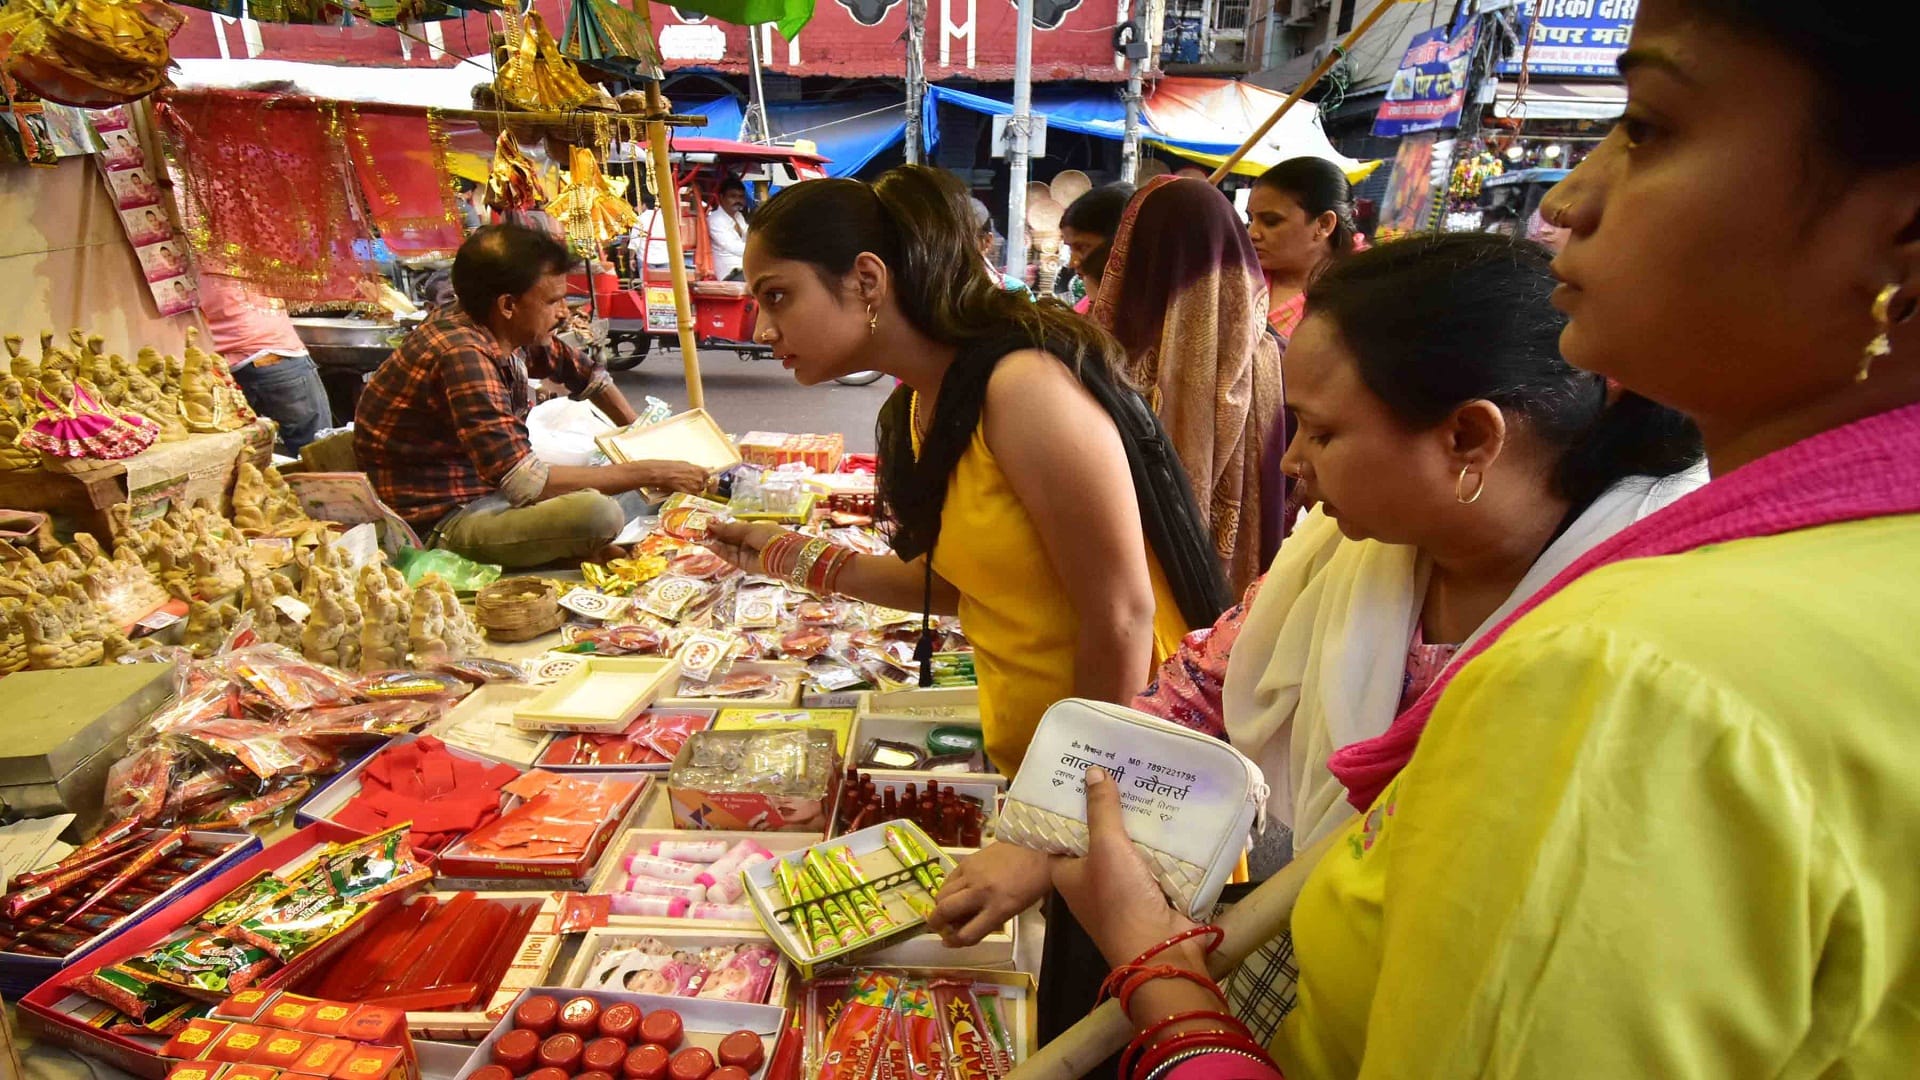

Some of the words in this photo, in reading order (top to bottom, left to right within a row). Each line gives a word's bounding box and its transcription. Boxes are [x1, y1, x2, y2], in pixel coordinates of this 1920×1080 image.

[1060, 752, 1127, 784] लालणी
[1134, 774, 1193, 801] ज्वैलर्स
[1147, 761, 1197, 783] 7897221795
[1120, 802, 1153, 817] लाहाबाद
